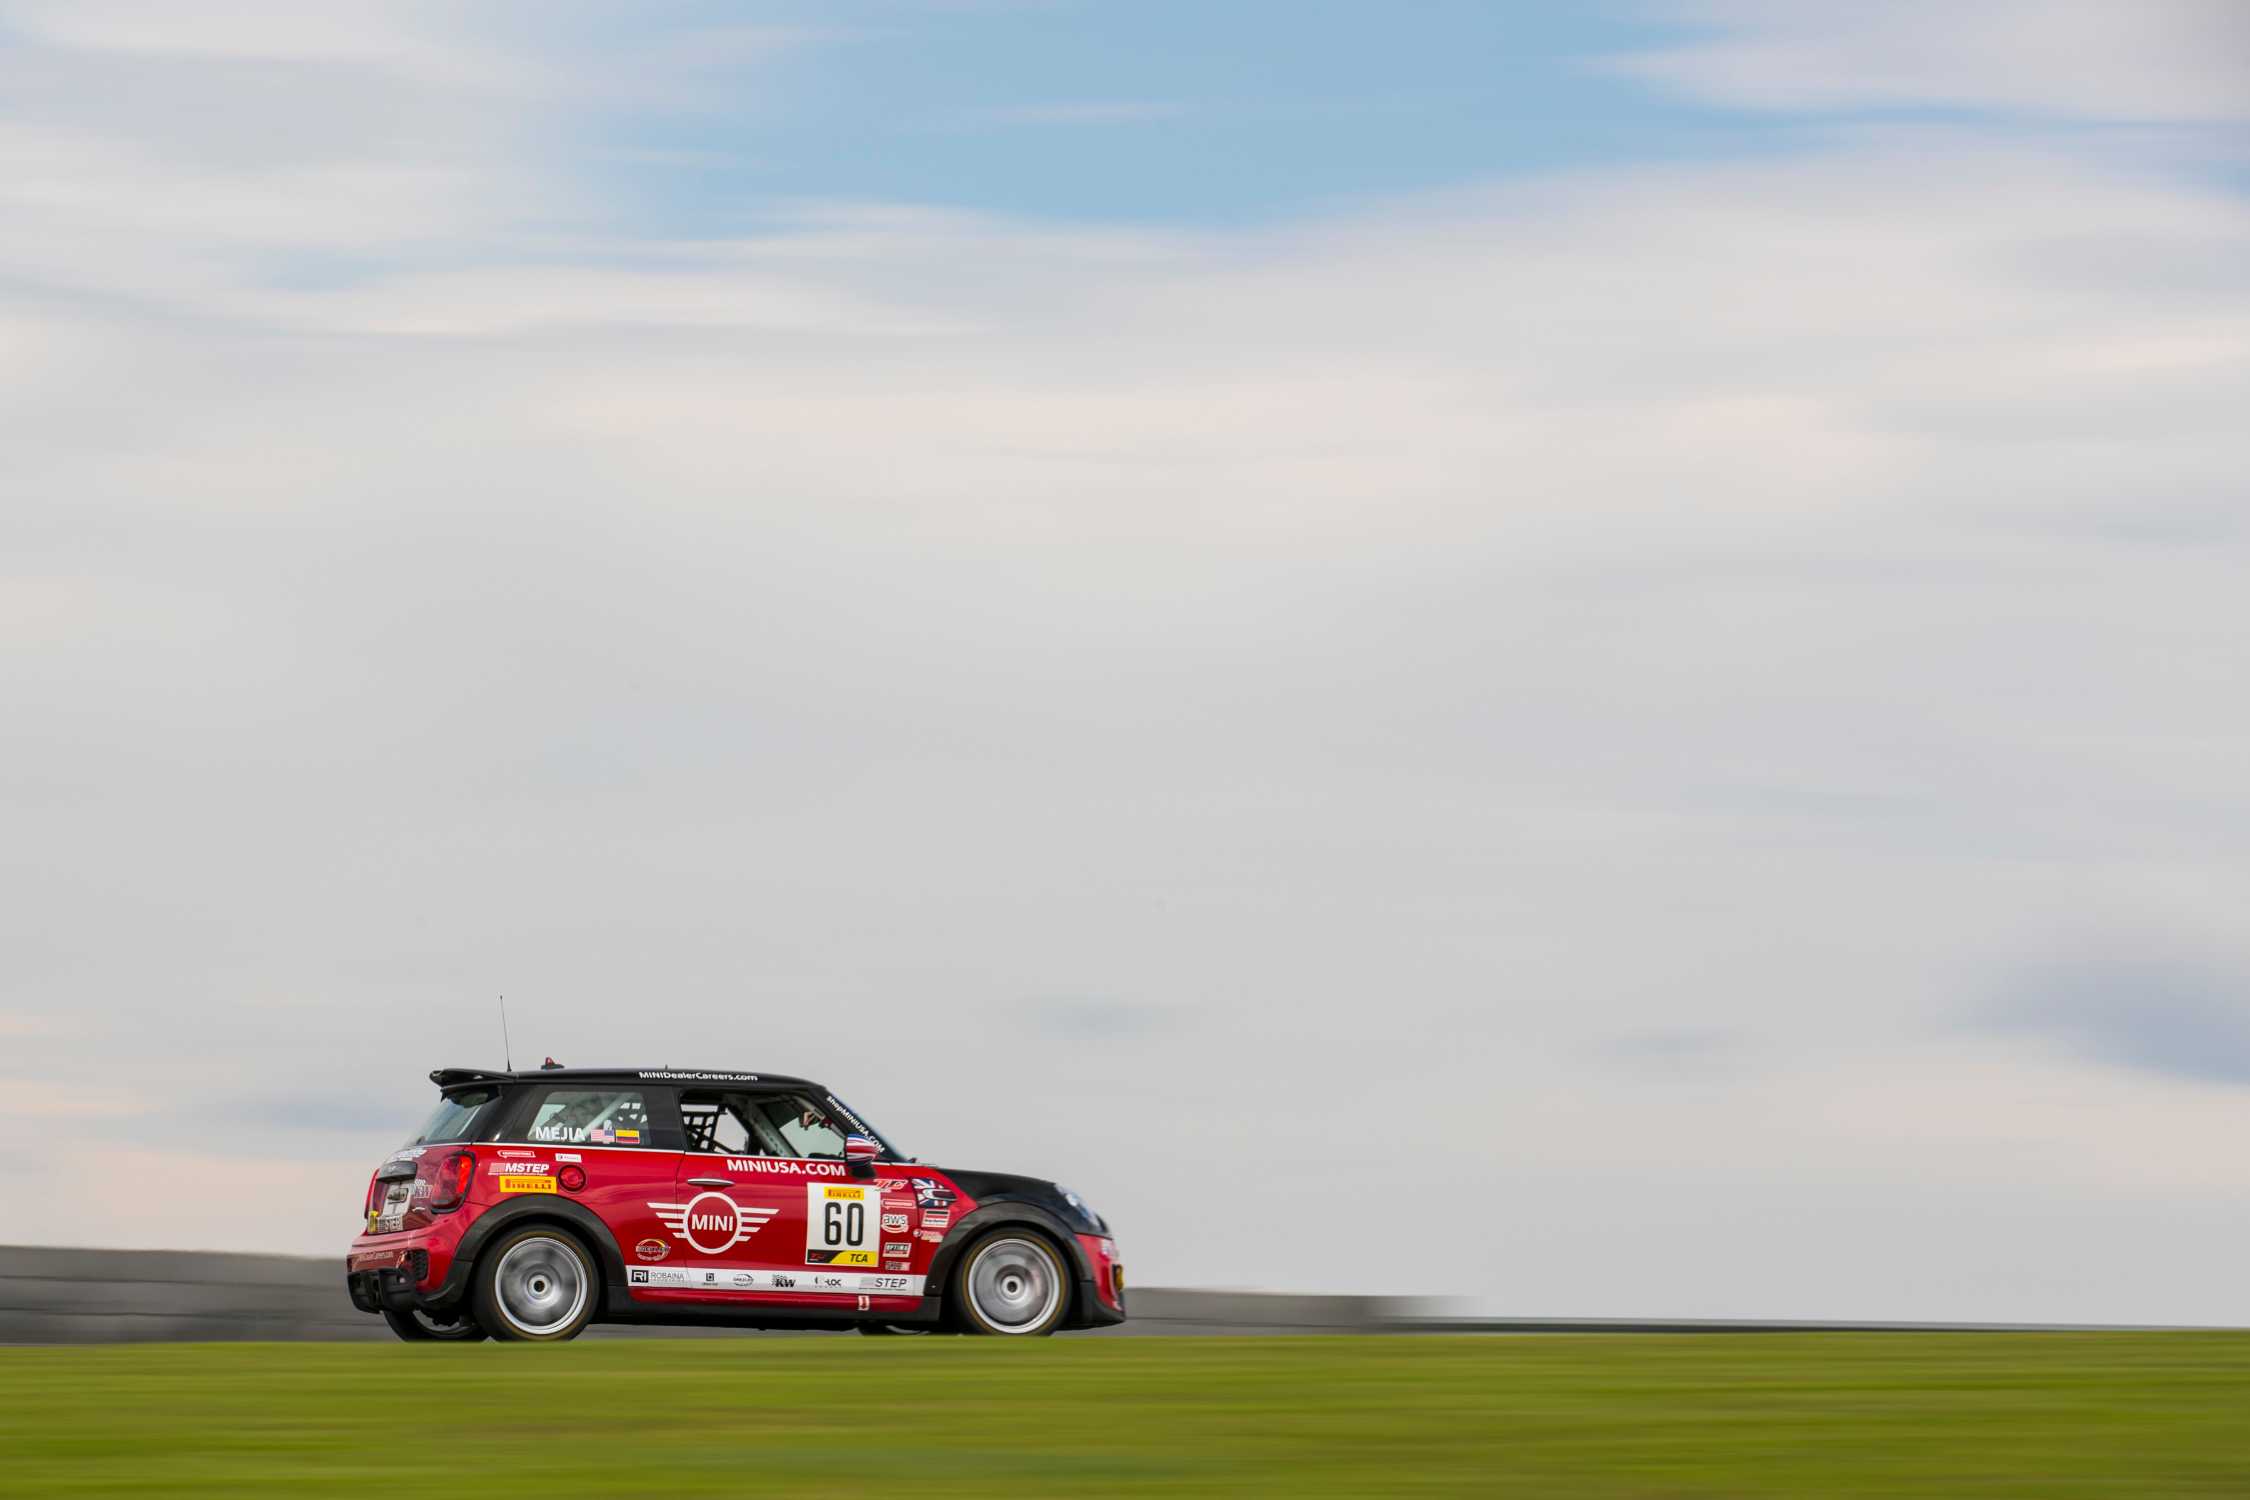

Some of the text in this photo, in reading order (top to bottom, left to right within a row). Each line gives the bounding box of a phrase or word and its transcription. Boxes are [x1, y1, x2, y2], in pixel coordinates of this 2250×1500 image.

[639, 1071, 758, 1081] MINIDealerCareers.com
[535, 1126, 586, 1142] MEJIA
[504, 1162, 550, 1173] MSTEP
[726, 1159, 846, 1177] MINIUSA.COM
[827, 1188, 862, 1199] PIRELLI
[691, 1213, 734, 1232] MINI
[824, 1201, 864, 1247] 60
[884, 1215, 907, 1225] aws
[849, 1253, 869, 1263] TCA
[775, 1278, 796, 1288] KW
